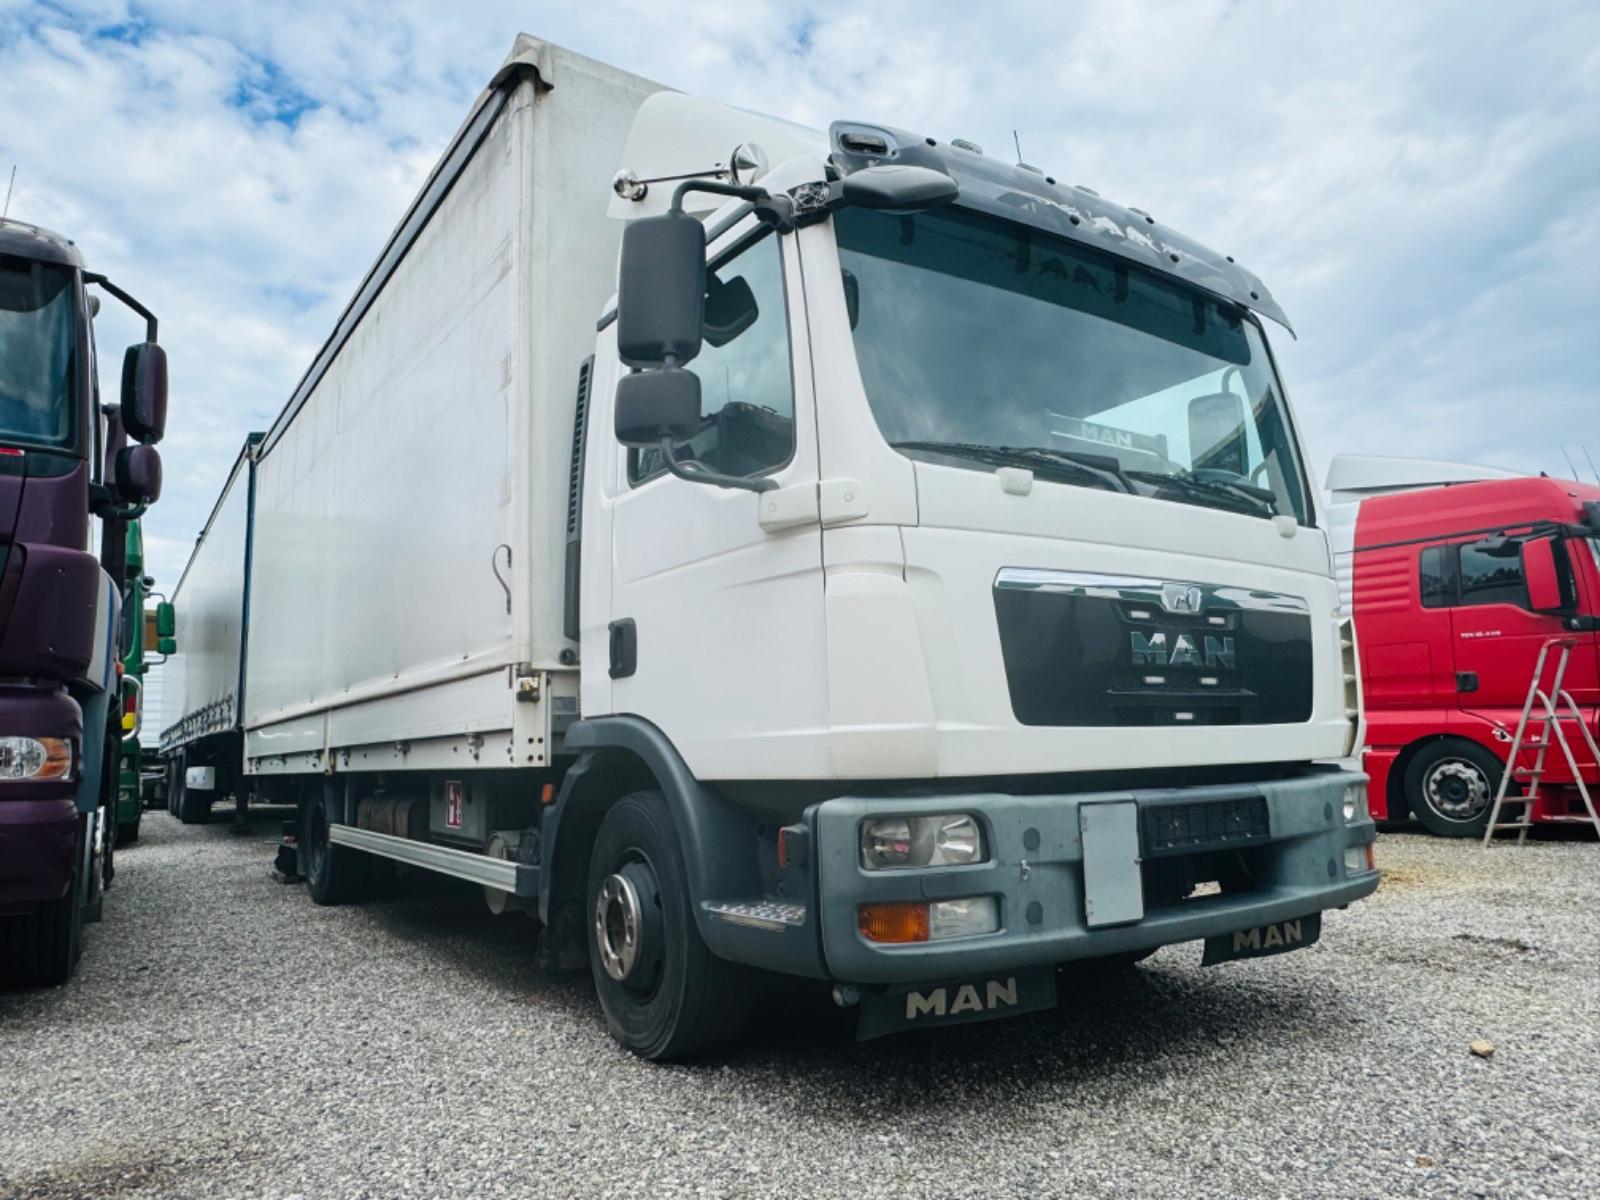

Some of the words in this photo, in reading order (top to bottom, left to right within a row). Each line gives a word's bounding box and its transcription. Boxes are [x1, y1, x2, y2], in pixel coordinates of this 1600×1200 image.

[1081, 423, 1132, 448] MAN
[1130, 631, 1234, 669] MAN
[1233, 920, 1302, 953] MAN
[905, 978, 1018, 1019] MAN
